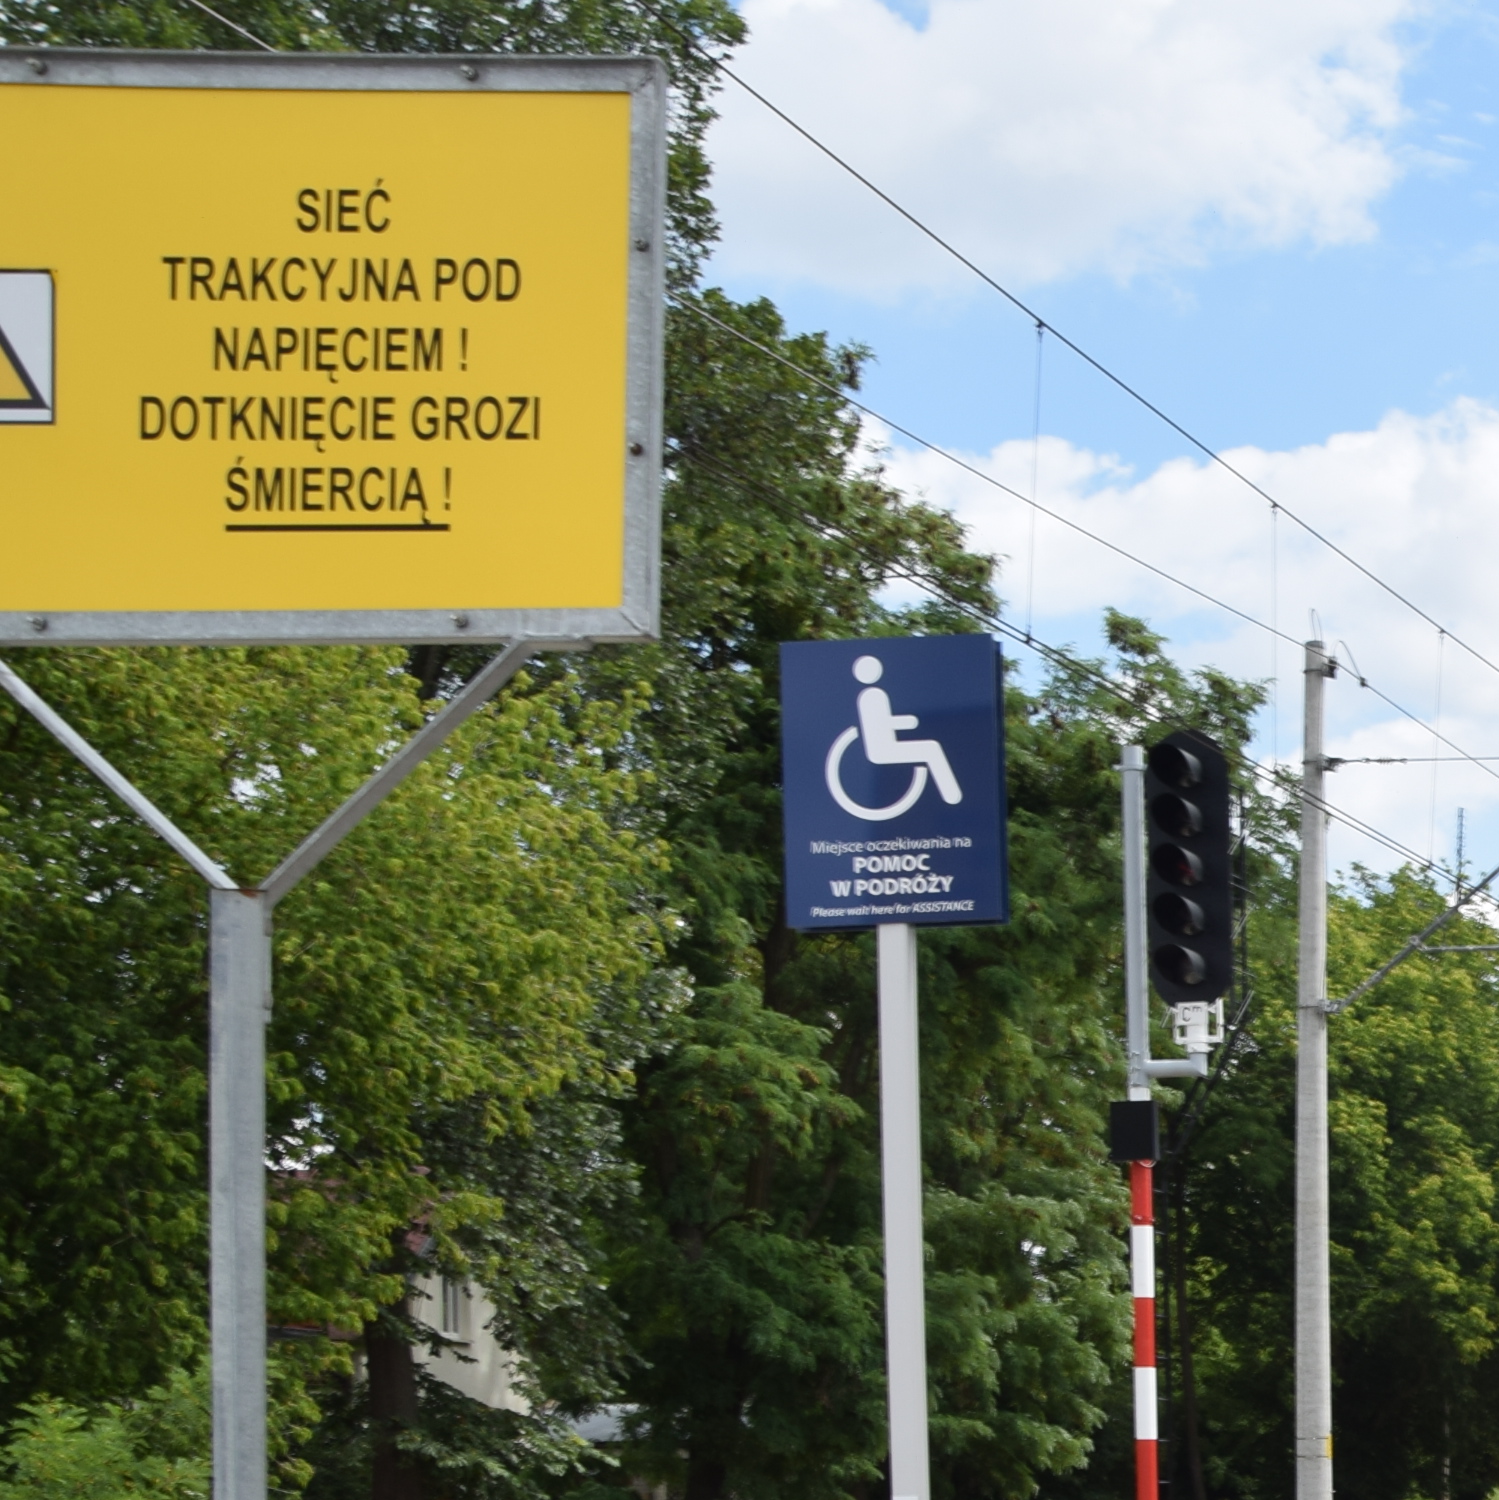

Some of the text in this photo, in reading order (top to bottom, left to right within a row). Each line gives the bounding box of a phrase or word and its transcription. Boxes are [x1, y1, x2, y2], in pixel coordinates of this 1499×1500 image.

[295, 179, 392, 234] SIEĆ
[161, 256, 522, 303] TRAKCYJNA POD
[212, 327, 444, 385] NAPIĘCIEM
[138, 396, 541, 453] DOTKNIĘCIE GROZI
[225, 456, 430, 525] ŚMIERCIĄ
[810, 836, 972, 856] Miejsce oczekiwania na
[852, 854, 931, 874] POMOC
[829, 872, 954, 897] W PODRÓŻY
[811, 900, 975, 918] Please wait here for ASSISTANCE
